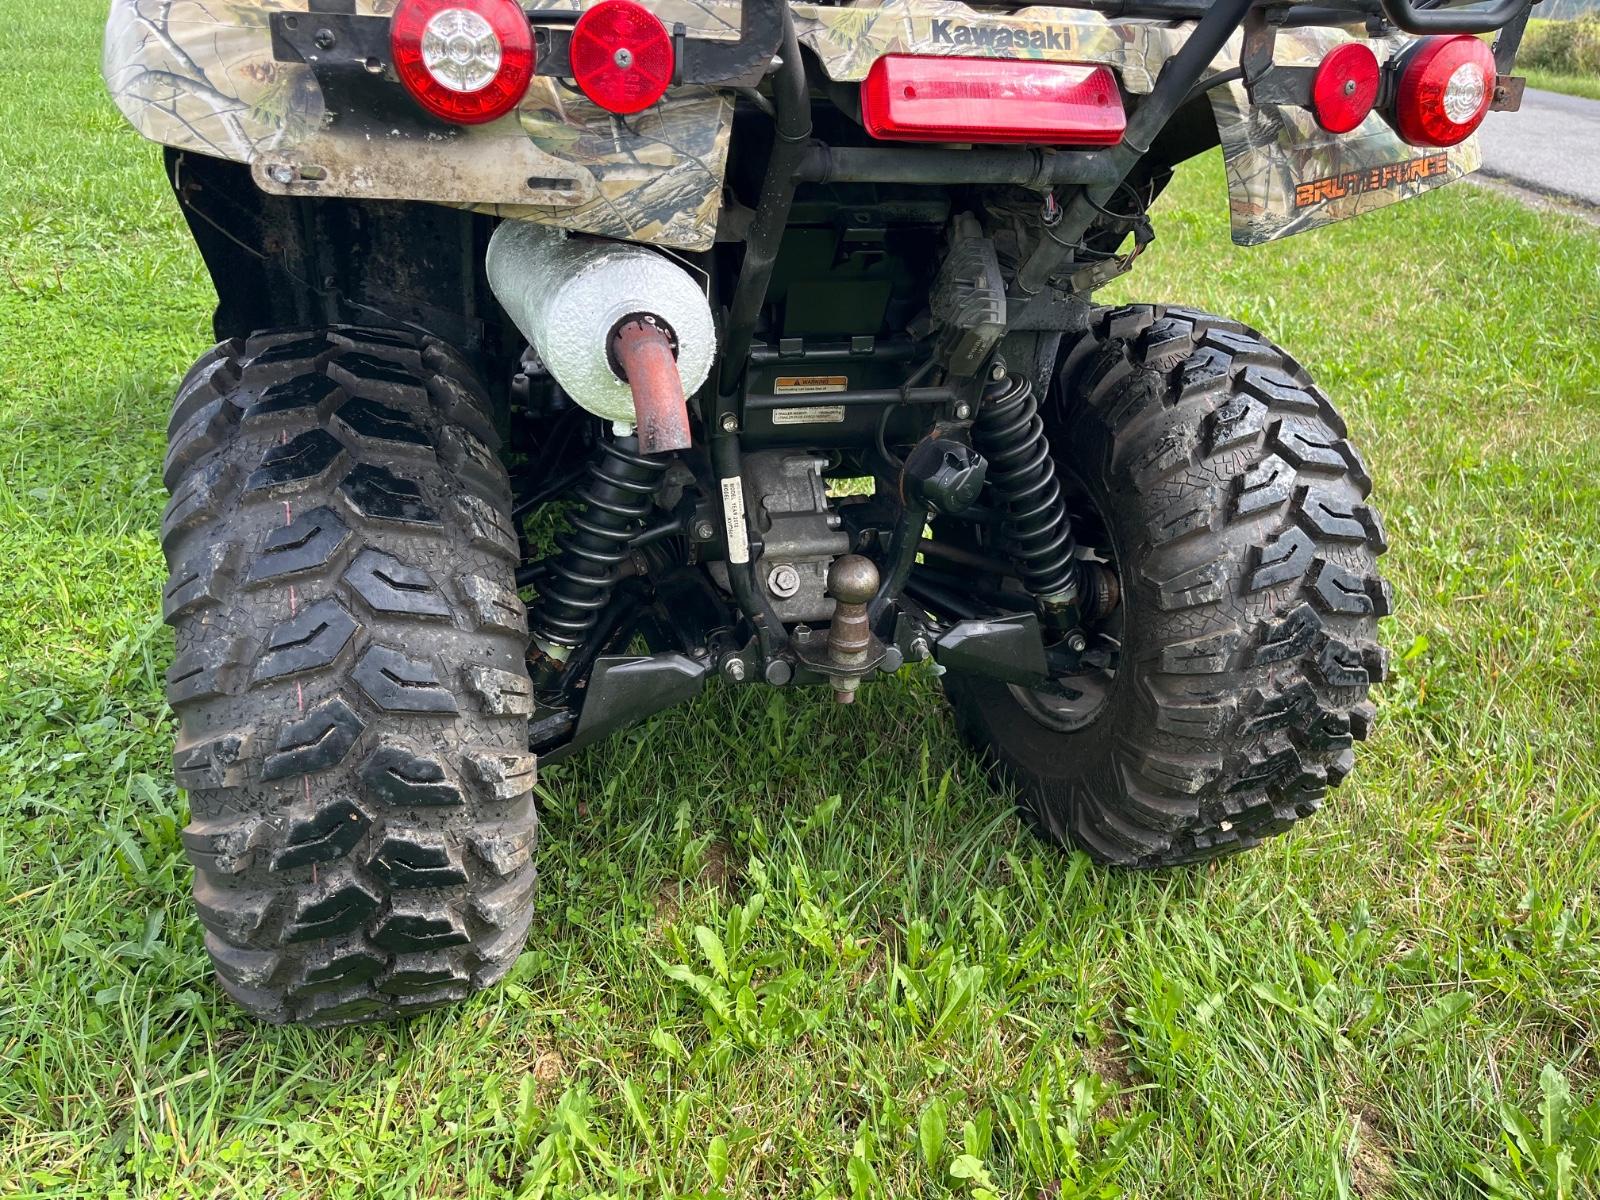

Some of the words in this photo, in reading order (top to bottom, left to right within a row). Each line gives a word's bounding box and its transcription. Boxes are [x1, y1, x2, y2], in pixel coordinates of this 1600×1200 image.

[931, 19, 1071, 50] Kawasaki
[1295, 167, 1380, 208] BRUTE
[1382, 152, 1448, 188] FORCE
